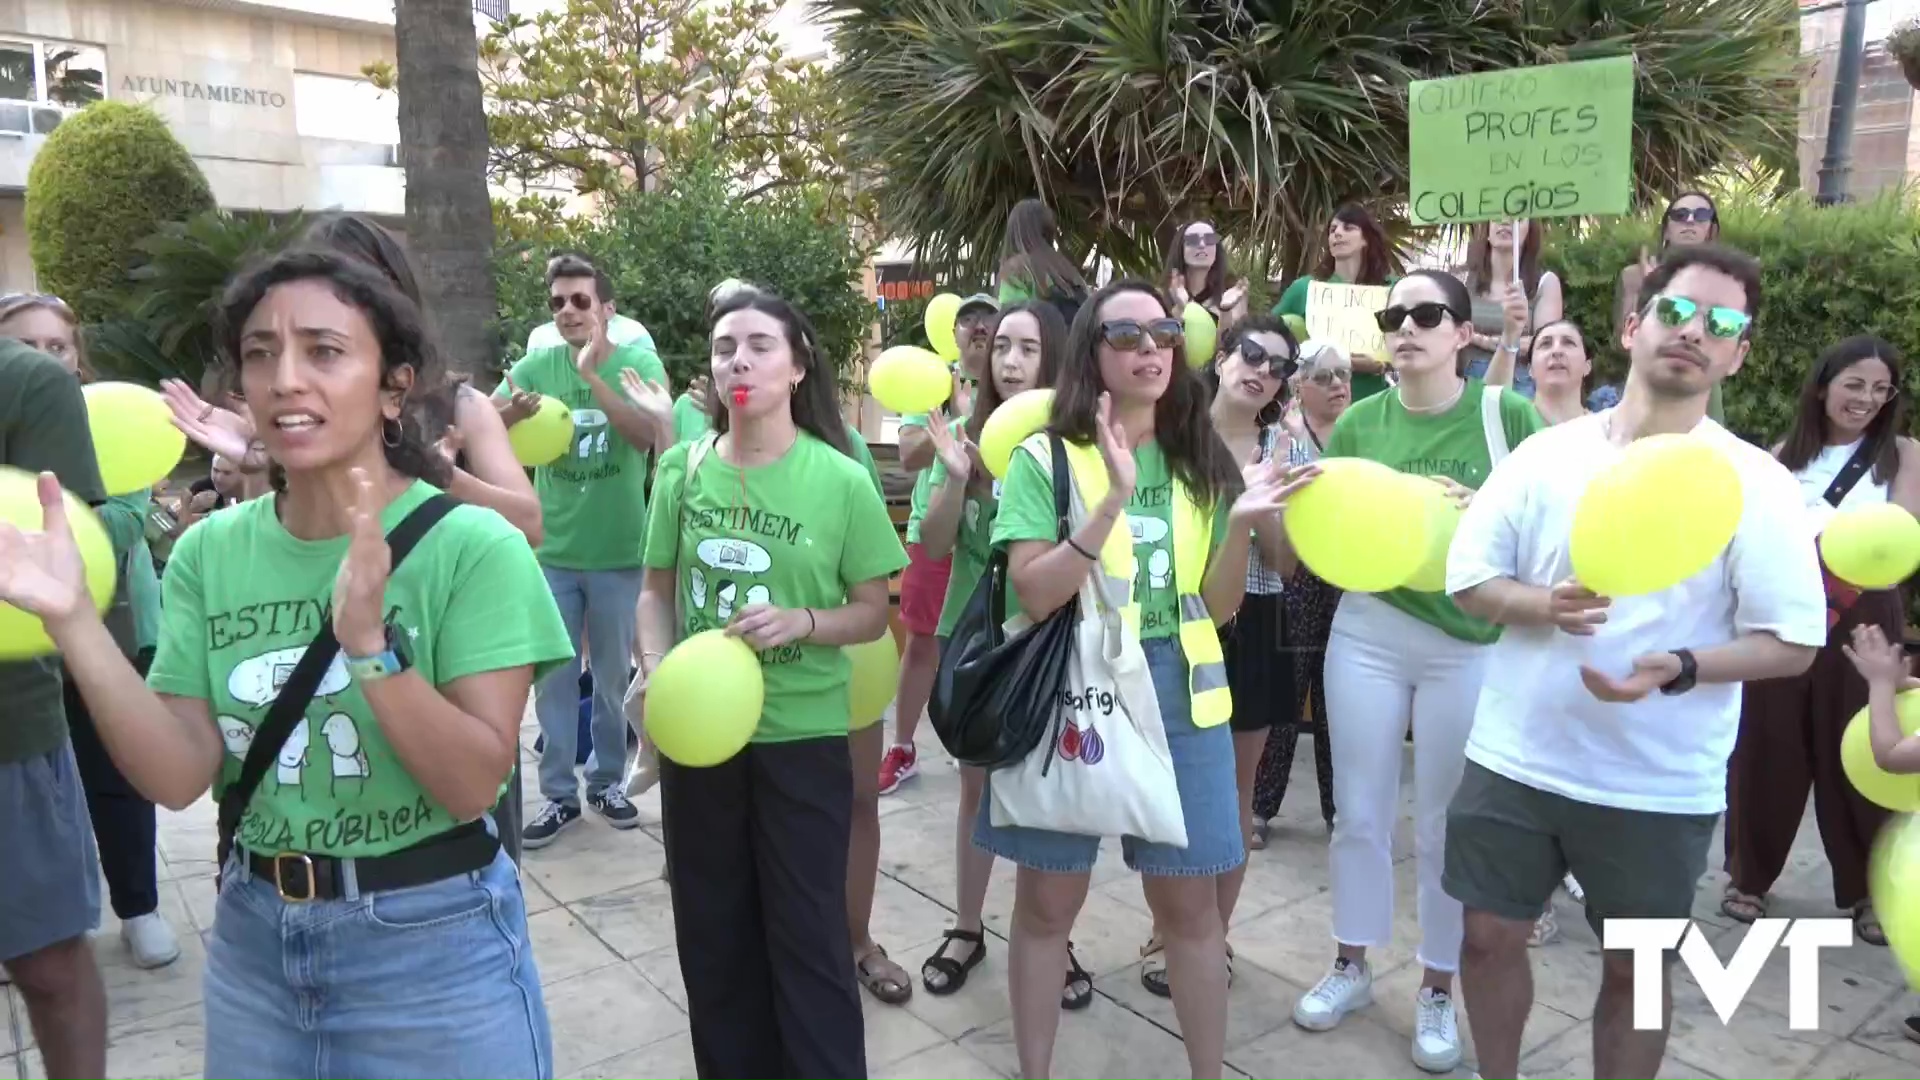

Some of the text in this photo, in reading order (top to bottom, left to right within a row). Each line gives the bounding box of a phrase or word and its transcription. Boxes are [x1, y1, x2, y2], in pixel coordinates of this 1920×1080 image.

[120, 75, 286, 108] AYUNTAMIENTO
[1466, 105, 1598, 144] PROFES
[1542, 142, 1602, 168] LOS
